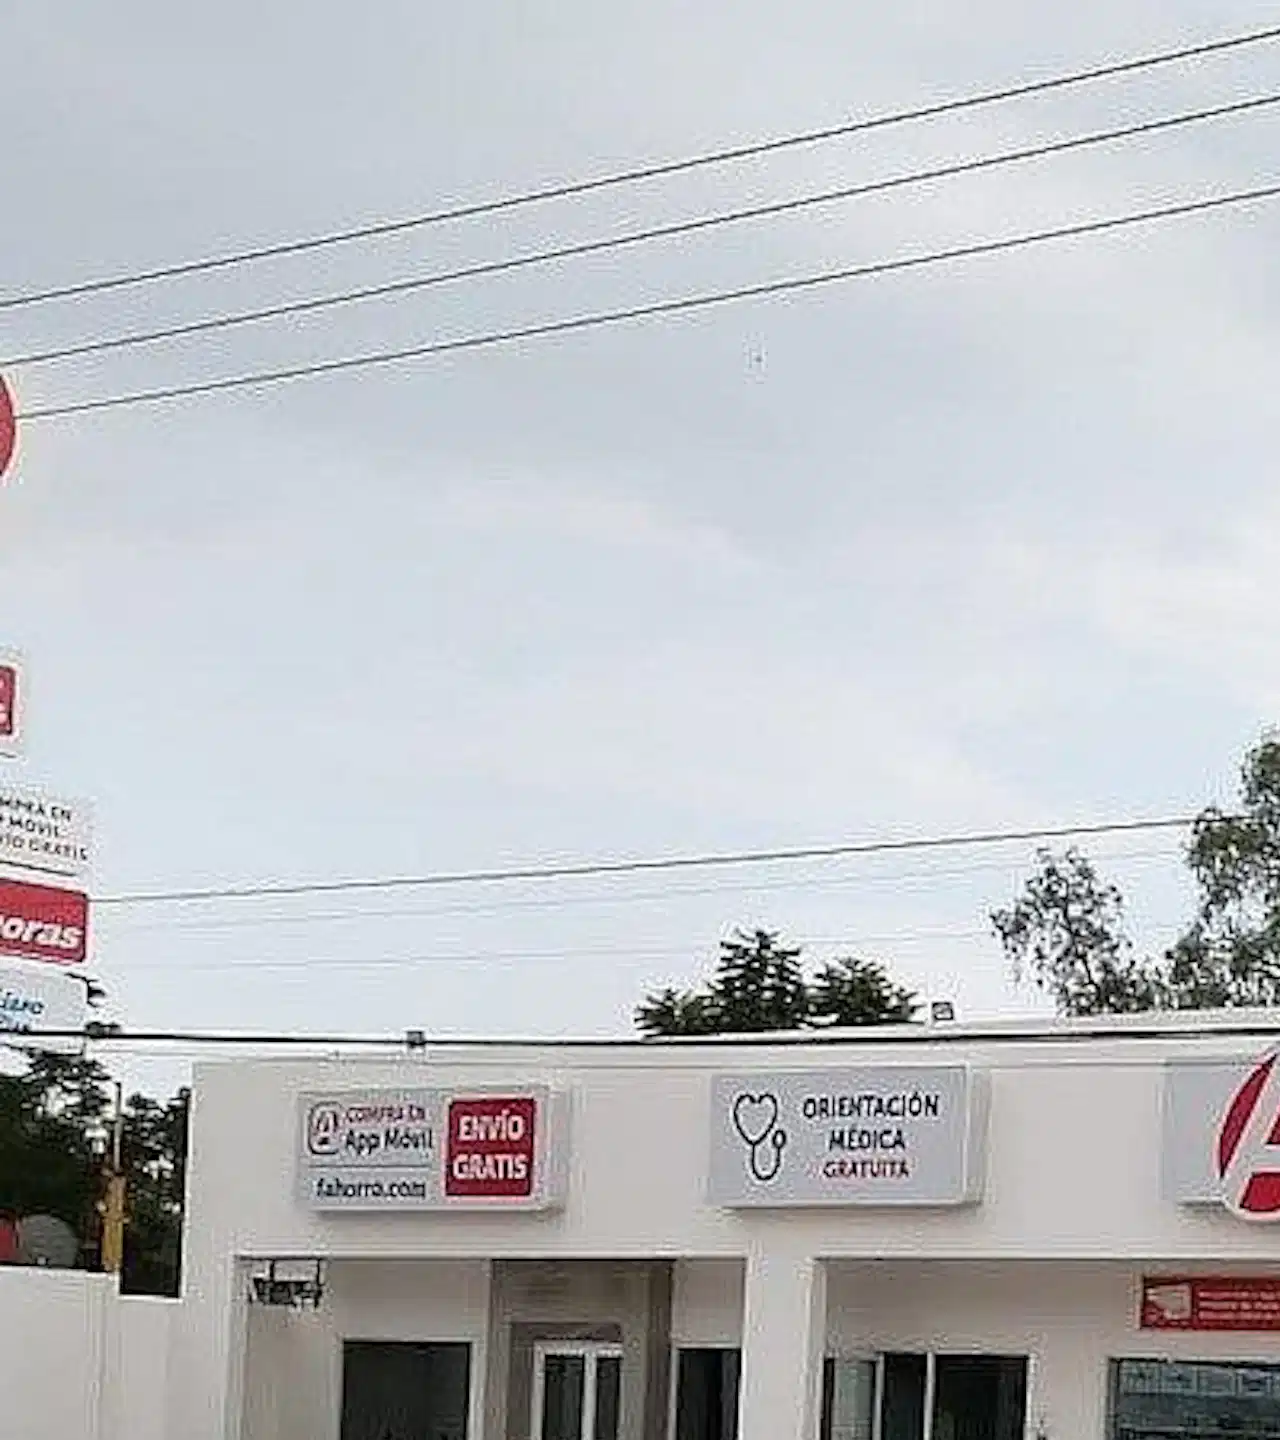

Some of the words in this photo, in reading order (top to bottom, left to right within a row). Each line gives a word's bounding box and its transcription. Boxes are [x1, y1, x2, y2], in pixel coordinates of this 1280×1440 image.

[0, 914, 85, 950] oras
[803, 1093, 940, 1119] ORIENTACIÓN
[346, 1127, 380, 1155] App
[452, 1153, 529, 1180] GRATIS
[822, 1159, 910, 1179] GRATUITA
[316, 1177, 427, 1199] fahorro.com
